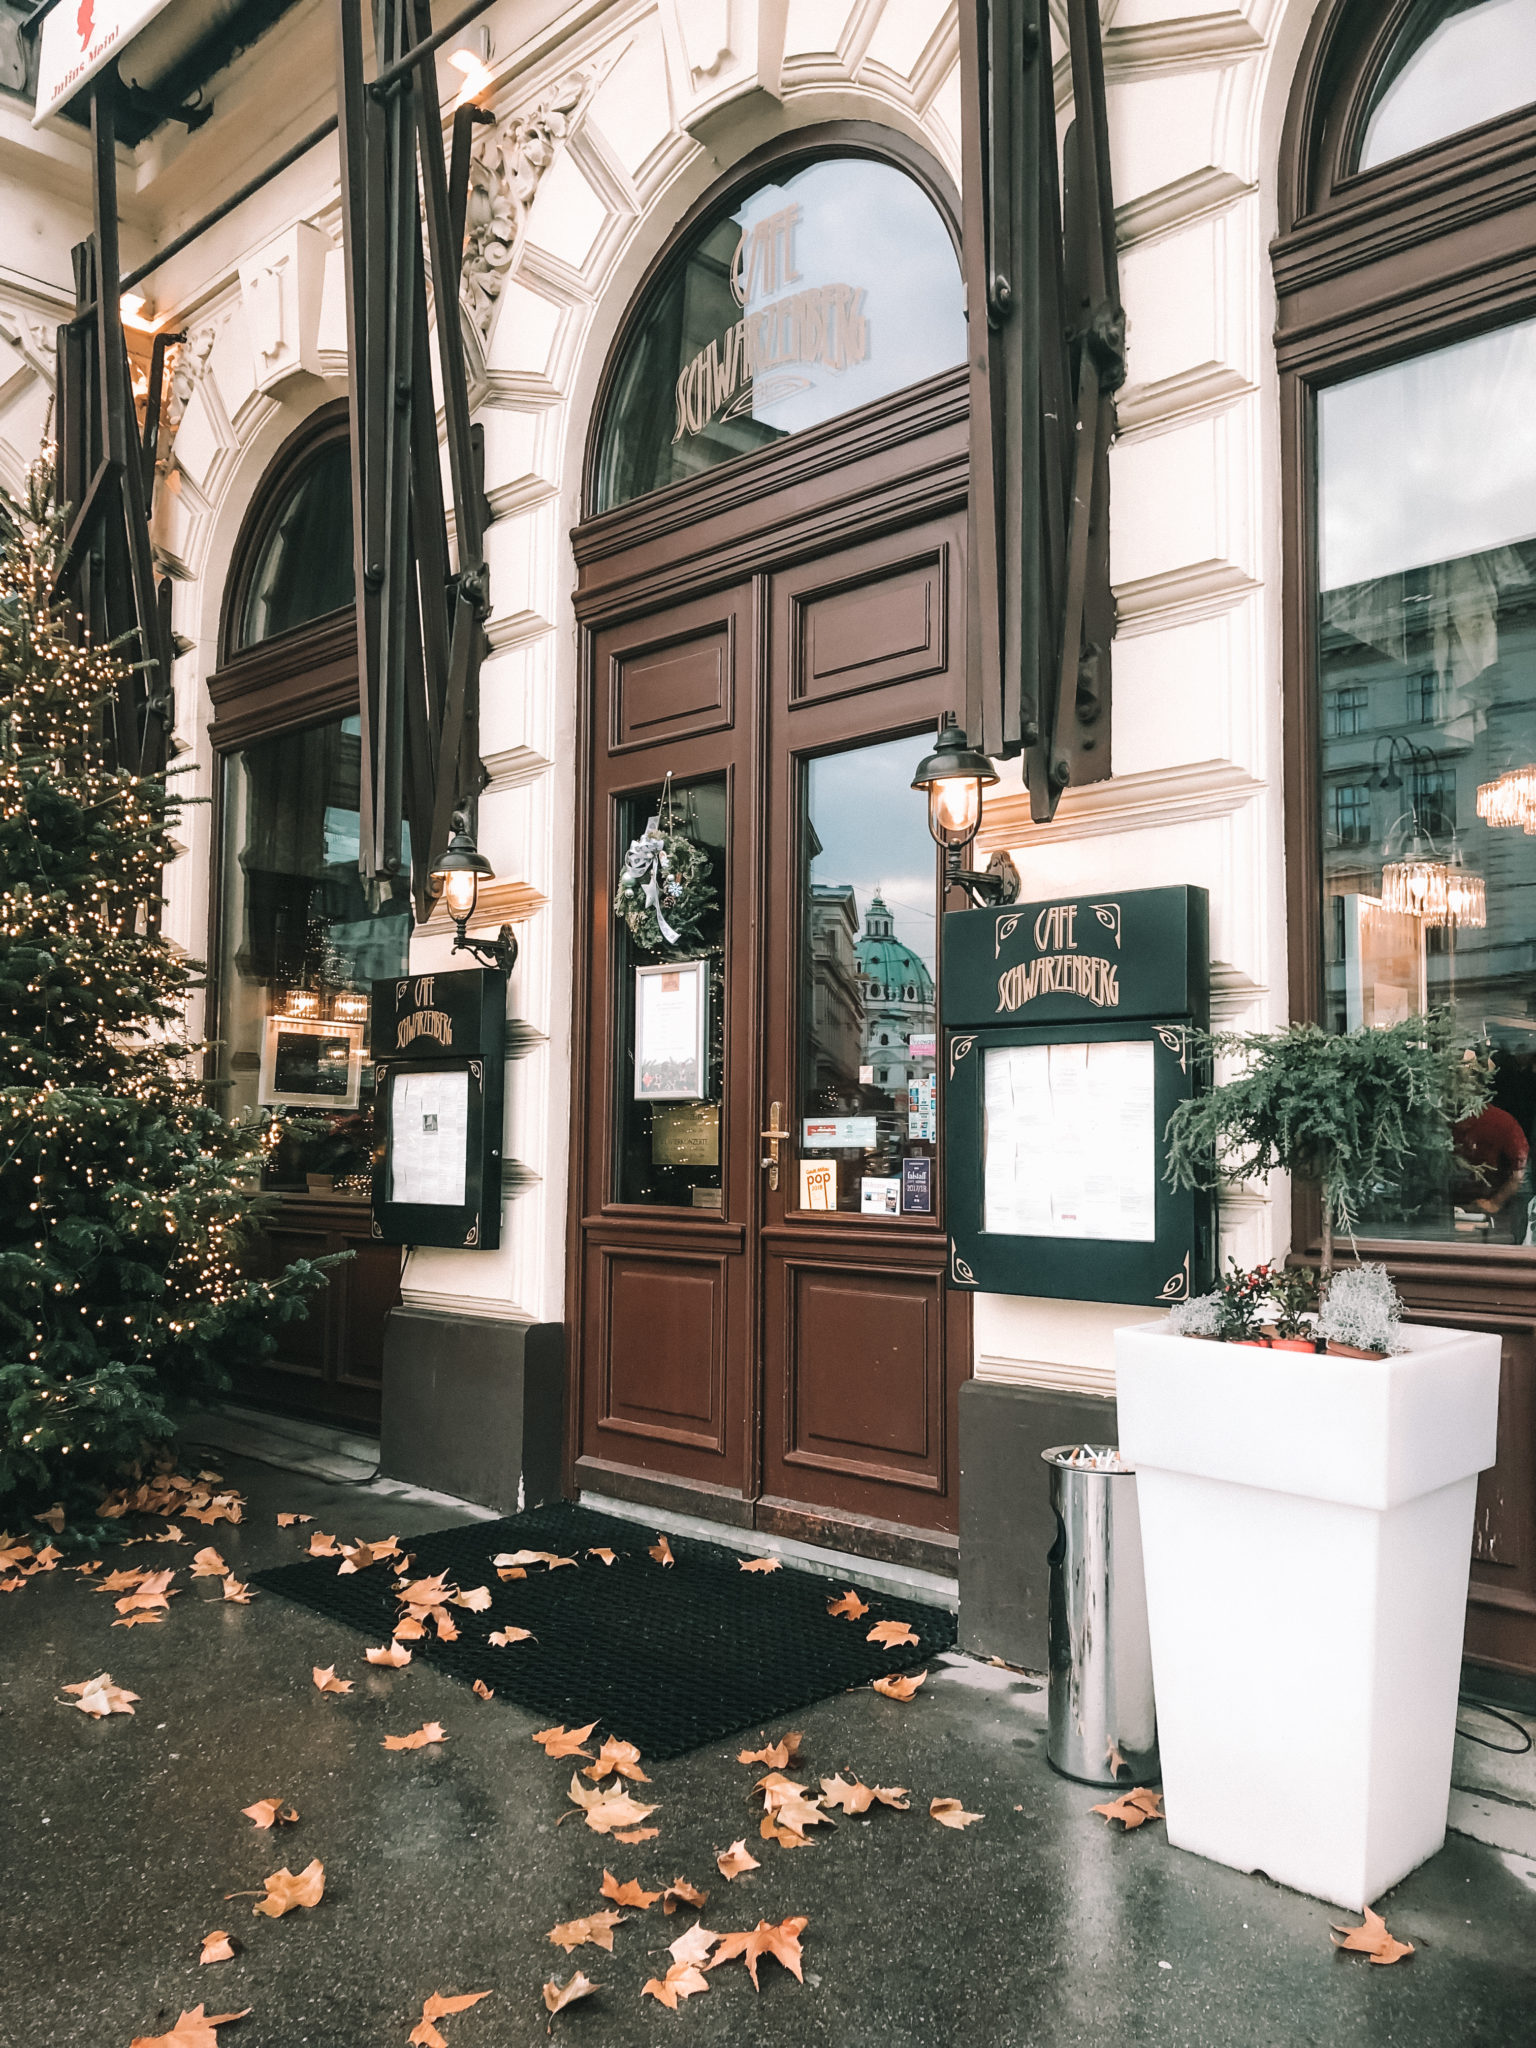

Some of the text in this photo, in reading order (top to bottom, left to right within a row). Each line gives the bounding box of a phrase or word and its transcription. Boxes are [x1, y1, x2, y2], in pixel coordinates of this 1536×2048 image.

[671, 282, 870, 445] SCHWARZENBERG
[995, 954, 1119, 1013] SCHWARZENBERG
[396, 1010, 453, 1050] SCHWARZENBERG
